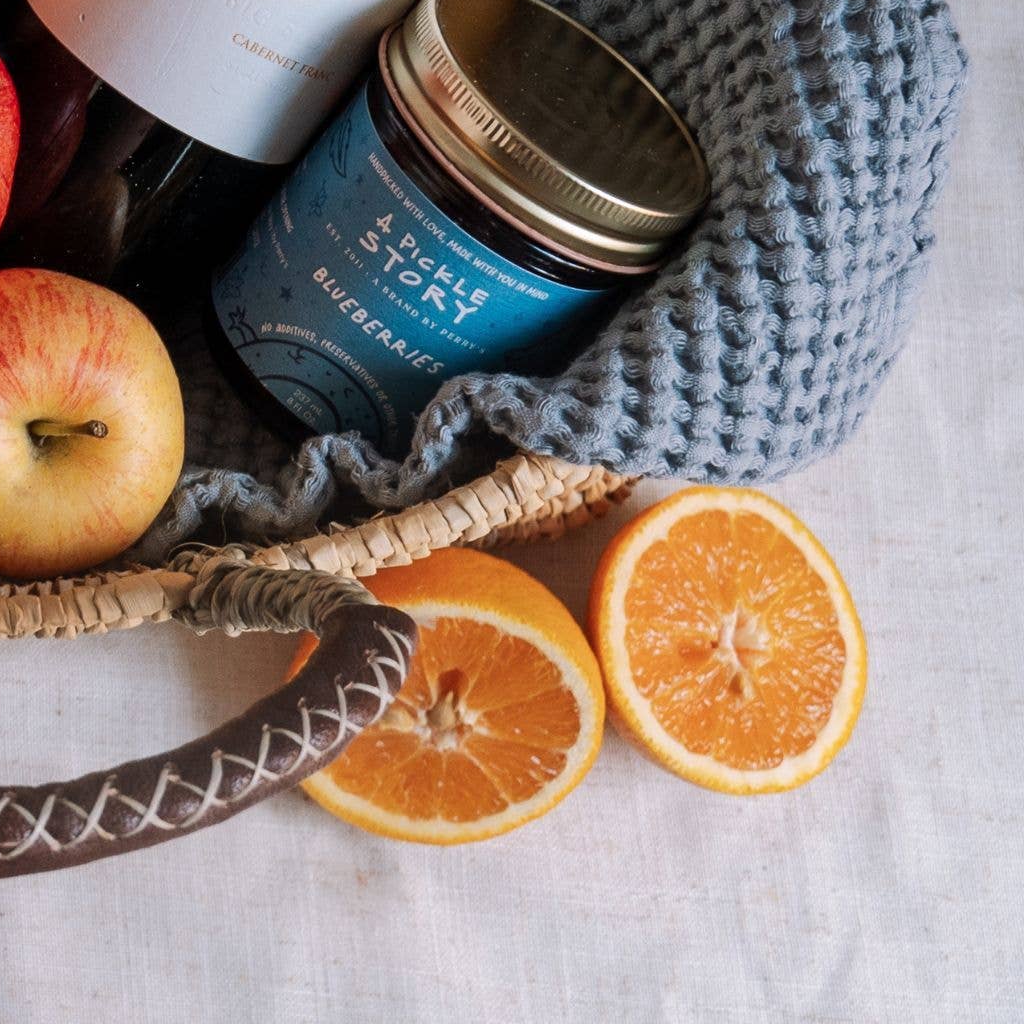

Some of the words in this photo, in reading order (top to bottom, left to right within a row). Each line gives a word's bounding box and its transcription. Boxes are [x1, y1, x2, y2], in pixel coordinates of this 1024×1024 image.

[232, 33, 300, 71] CABERNET
[367, 152, 404, 200] HANDPACKED
[402, 197, 425, 221] WITH
[422, 218, 447, 244] LOVE,
[446, 239, 474, 262] MADE
[472, 257, 498, 277] WITH
[496, 271, 518, 288] YOU
[514, 280, 530, 293] IN
[525, 286, 550, 302] MIND
[376, 213, 393, 234] A
[399, 232, 490, 306] PICKLE
[312, 266, 445, 374] BLUEBERRIES
[358, 230, 479, 325] STORY
[382, 286, 420, 318] BRAND
[421, 316, 439, 330] BY
[260, 321, 273, 334] NO
